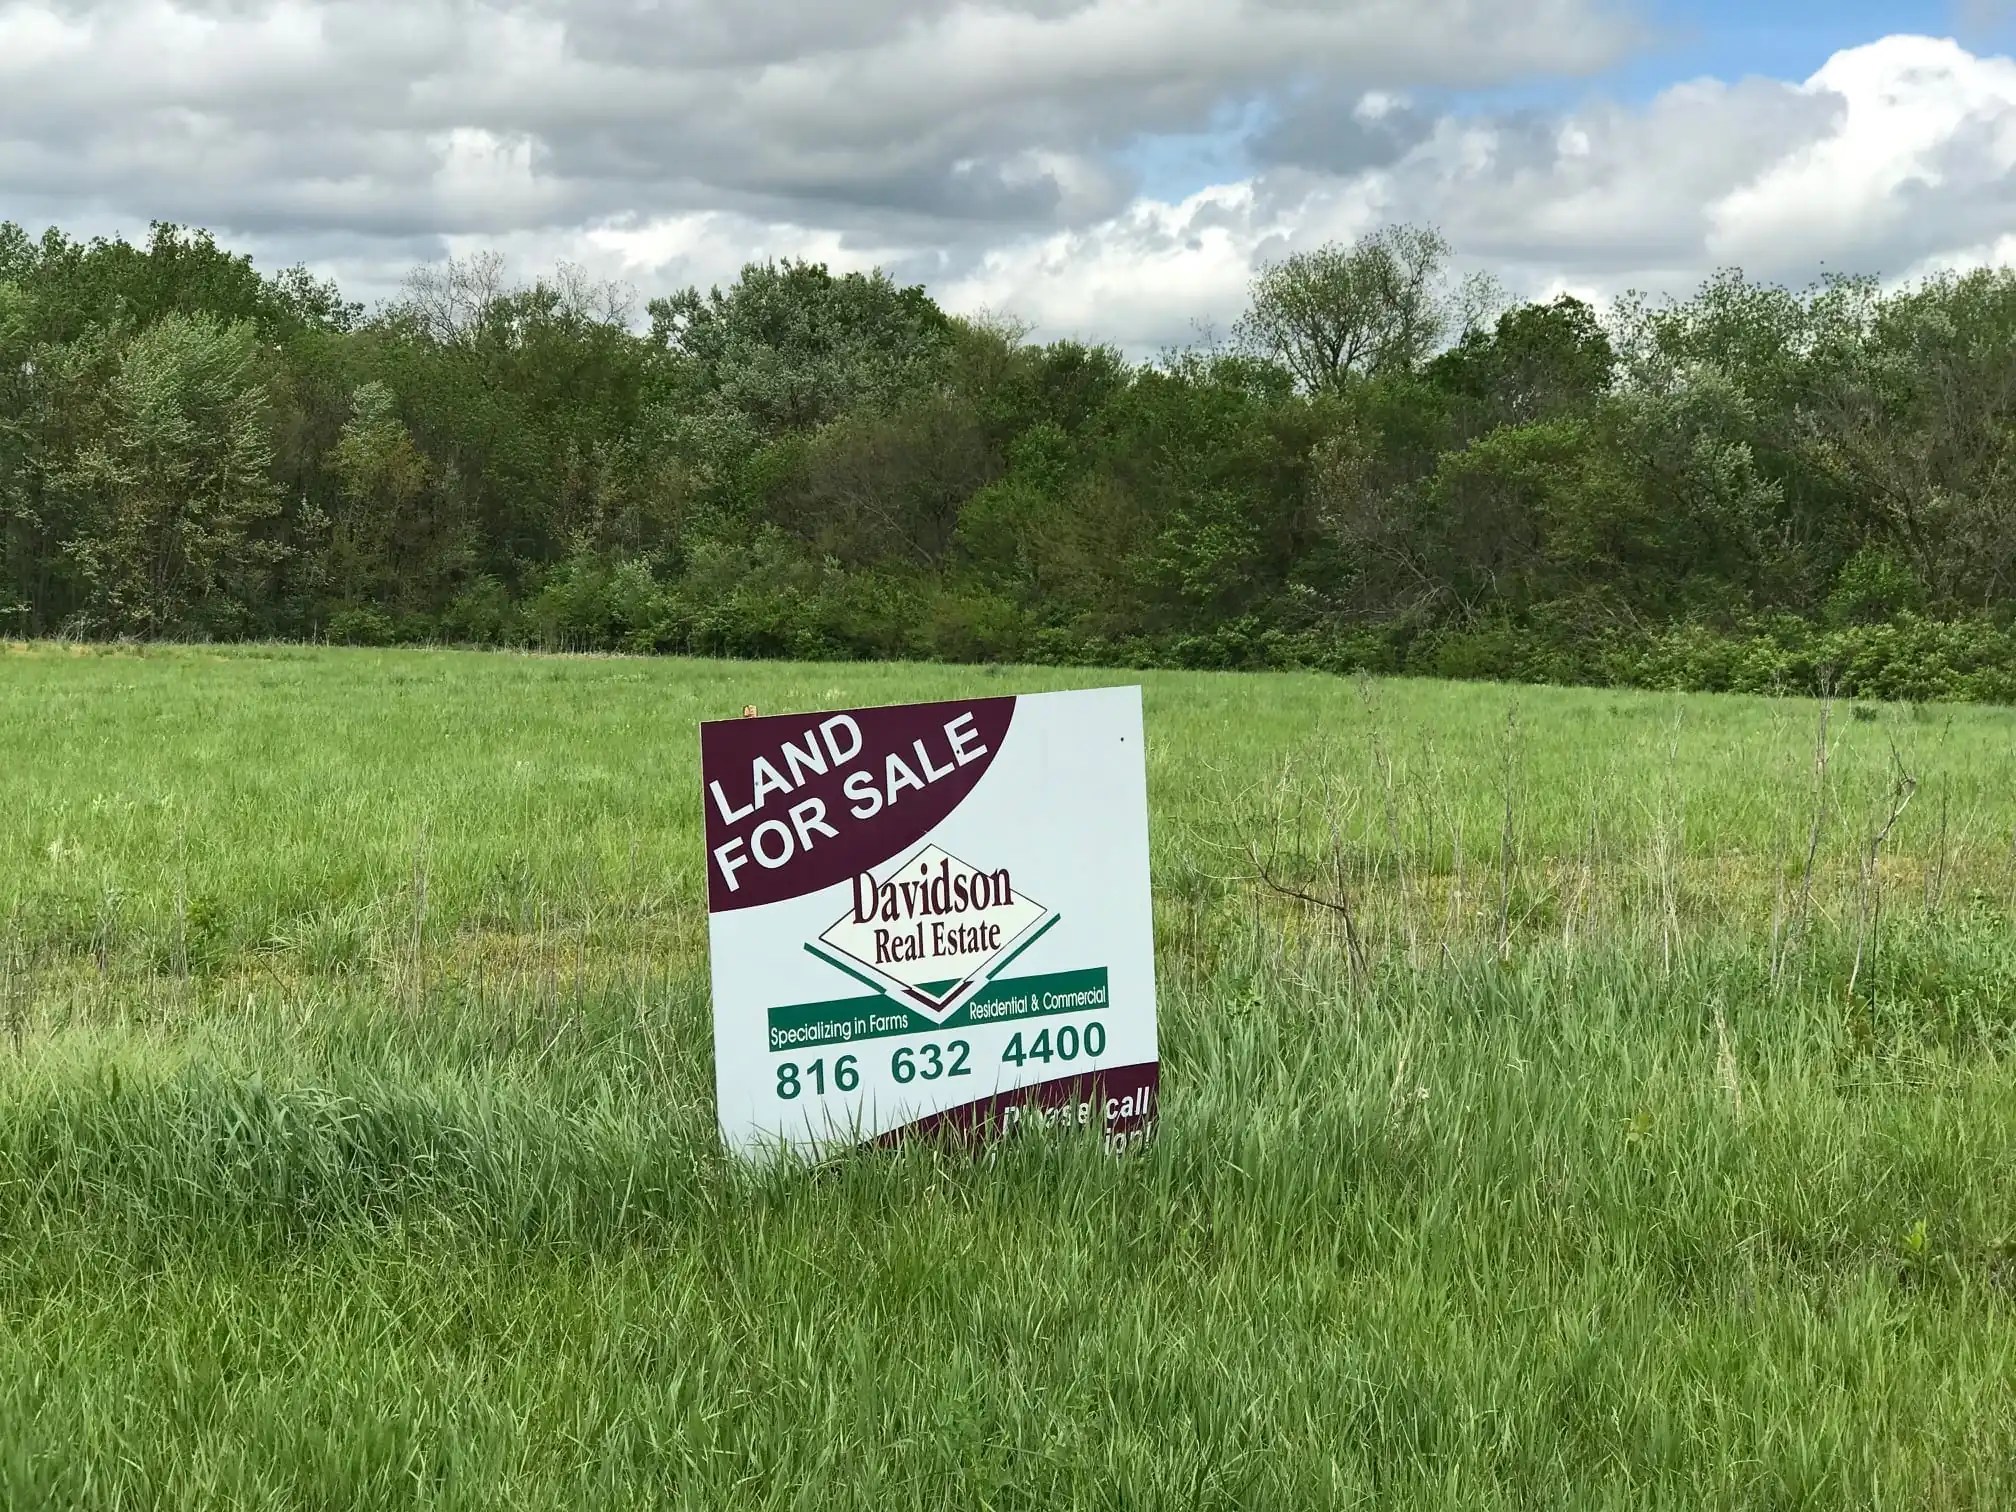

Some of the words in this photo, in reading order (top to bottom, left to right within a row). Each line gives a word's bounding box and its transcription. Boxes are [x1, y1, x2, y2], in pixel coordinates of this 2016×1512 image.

[709, 714, 863, 826] LAND
[713, 797, 840, 892] FOR
[843, 711, 988, 820] SALE
[852, 857, 1014, 925] Davidson
[874, 921, 925, 965] Real
[931, 920, 1001, 957] Estate
[770, 1019, 851, 1048] Specializing
[854, 1017, 867, 1035] in
[869, 1013, 908, 1032] Farms
[969, 993, 1028, 1020] Residential
[1031, 994, 1040, 1011] &
[1042, 985, 1107, 1009] Commercial
[776, 1054, 860, 1100] 816
[890, 1039, 972, 1084] 632
[1001, 1021, 1106, 1067] 4400
[1105, 1086, 1150, 1120] call
